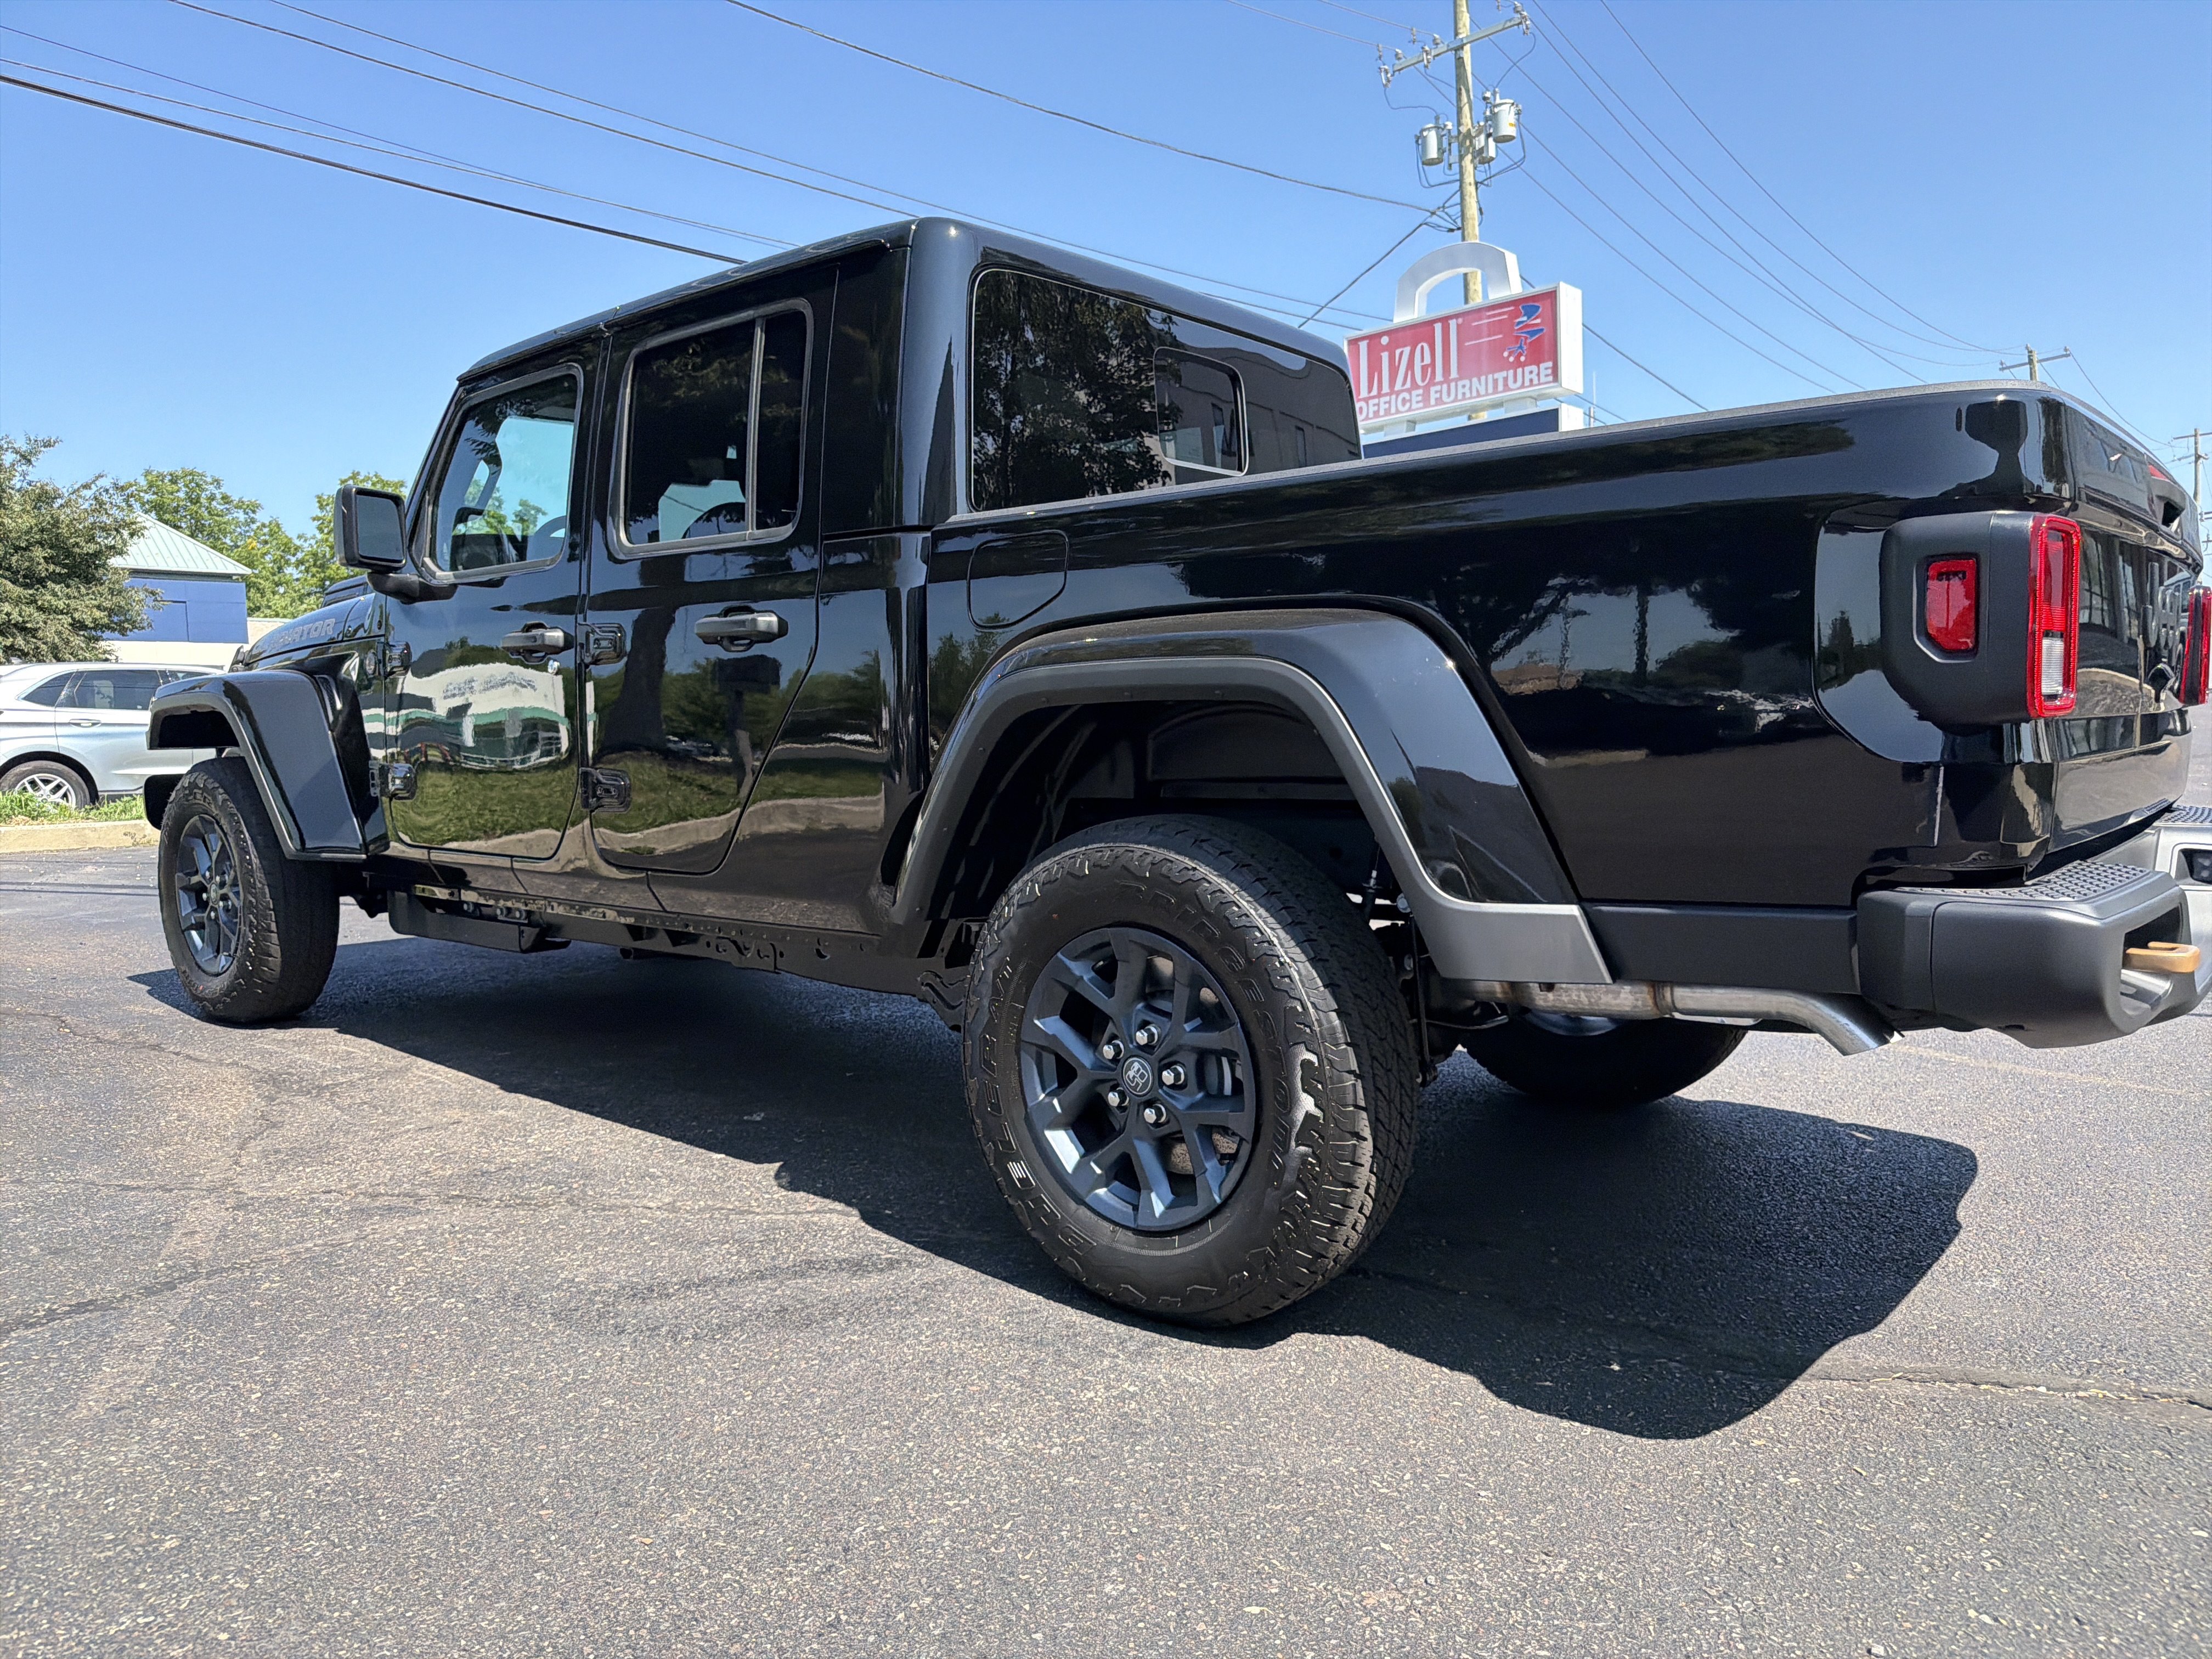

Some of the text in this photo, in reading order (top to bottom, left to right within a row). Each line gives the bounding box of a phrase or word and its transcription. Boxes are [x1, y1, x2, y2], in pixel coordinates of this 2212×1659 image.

[1357, 319, 1460, 399] Lizell
[1358, 361, 1554, 421] OFFICE FURNITURE
